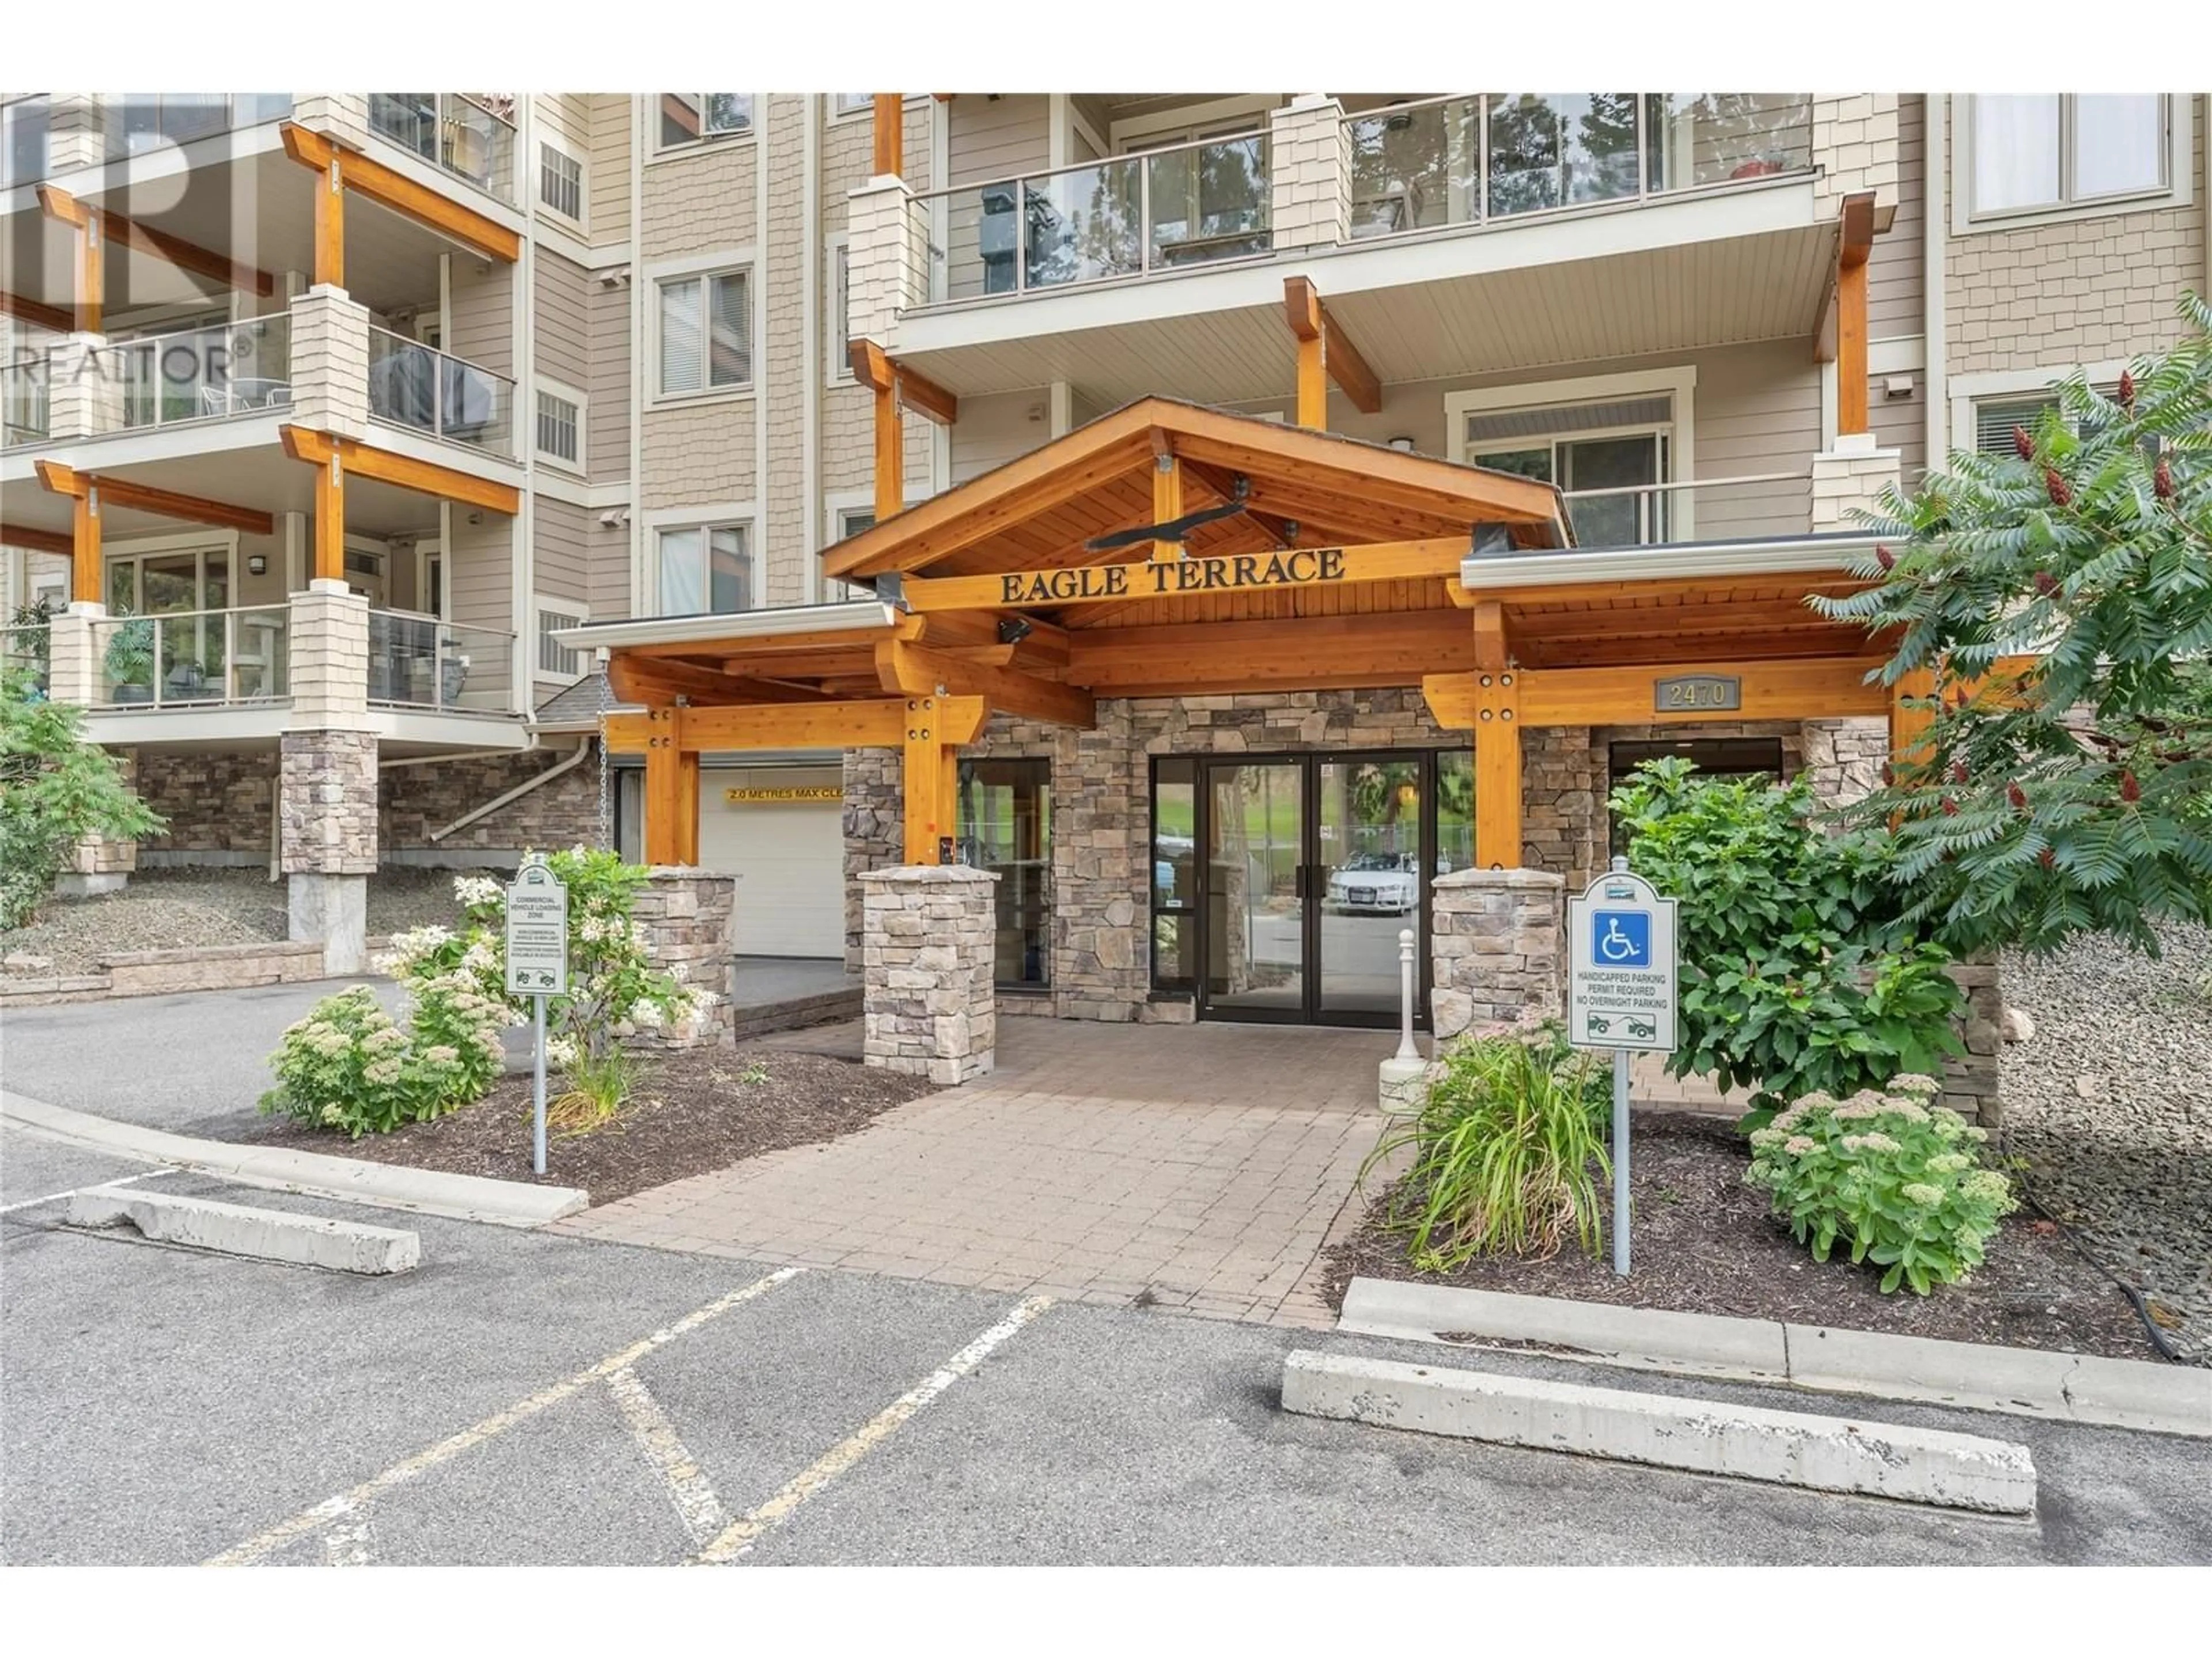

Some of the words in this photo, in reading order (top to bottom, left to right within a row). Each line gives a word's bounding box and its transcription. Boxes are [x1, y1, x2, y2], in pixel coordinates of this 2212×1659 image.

[1001, 566, 1128, 603] EAGLE
[1147, 548, 1345, 593] TERRACE
[1670, 684, 1724, 706] 2470
[749, 789, 792, 798] METRES
[795, 787, 819, 798] MAX
[1578, 972, 1630, 982] HANDICAPPED
[1632, 974, 1666, 984] PARKING
[1588, 984, 1614, 993] PERMIT
[1616, 985, 1656, 995] REQUIRED
[1577, 995, 1588, 1005] NO
[1589, 996, 1631, 1007] OVERNIGHT
[1634, 998, 1667, 1009] PARKING
